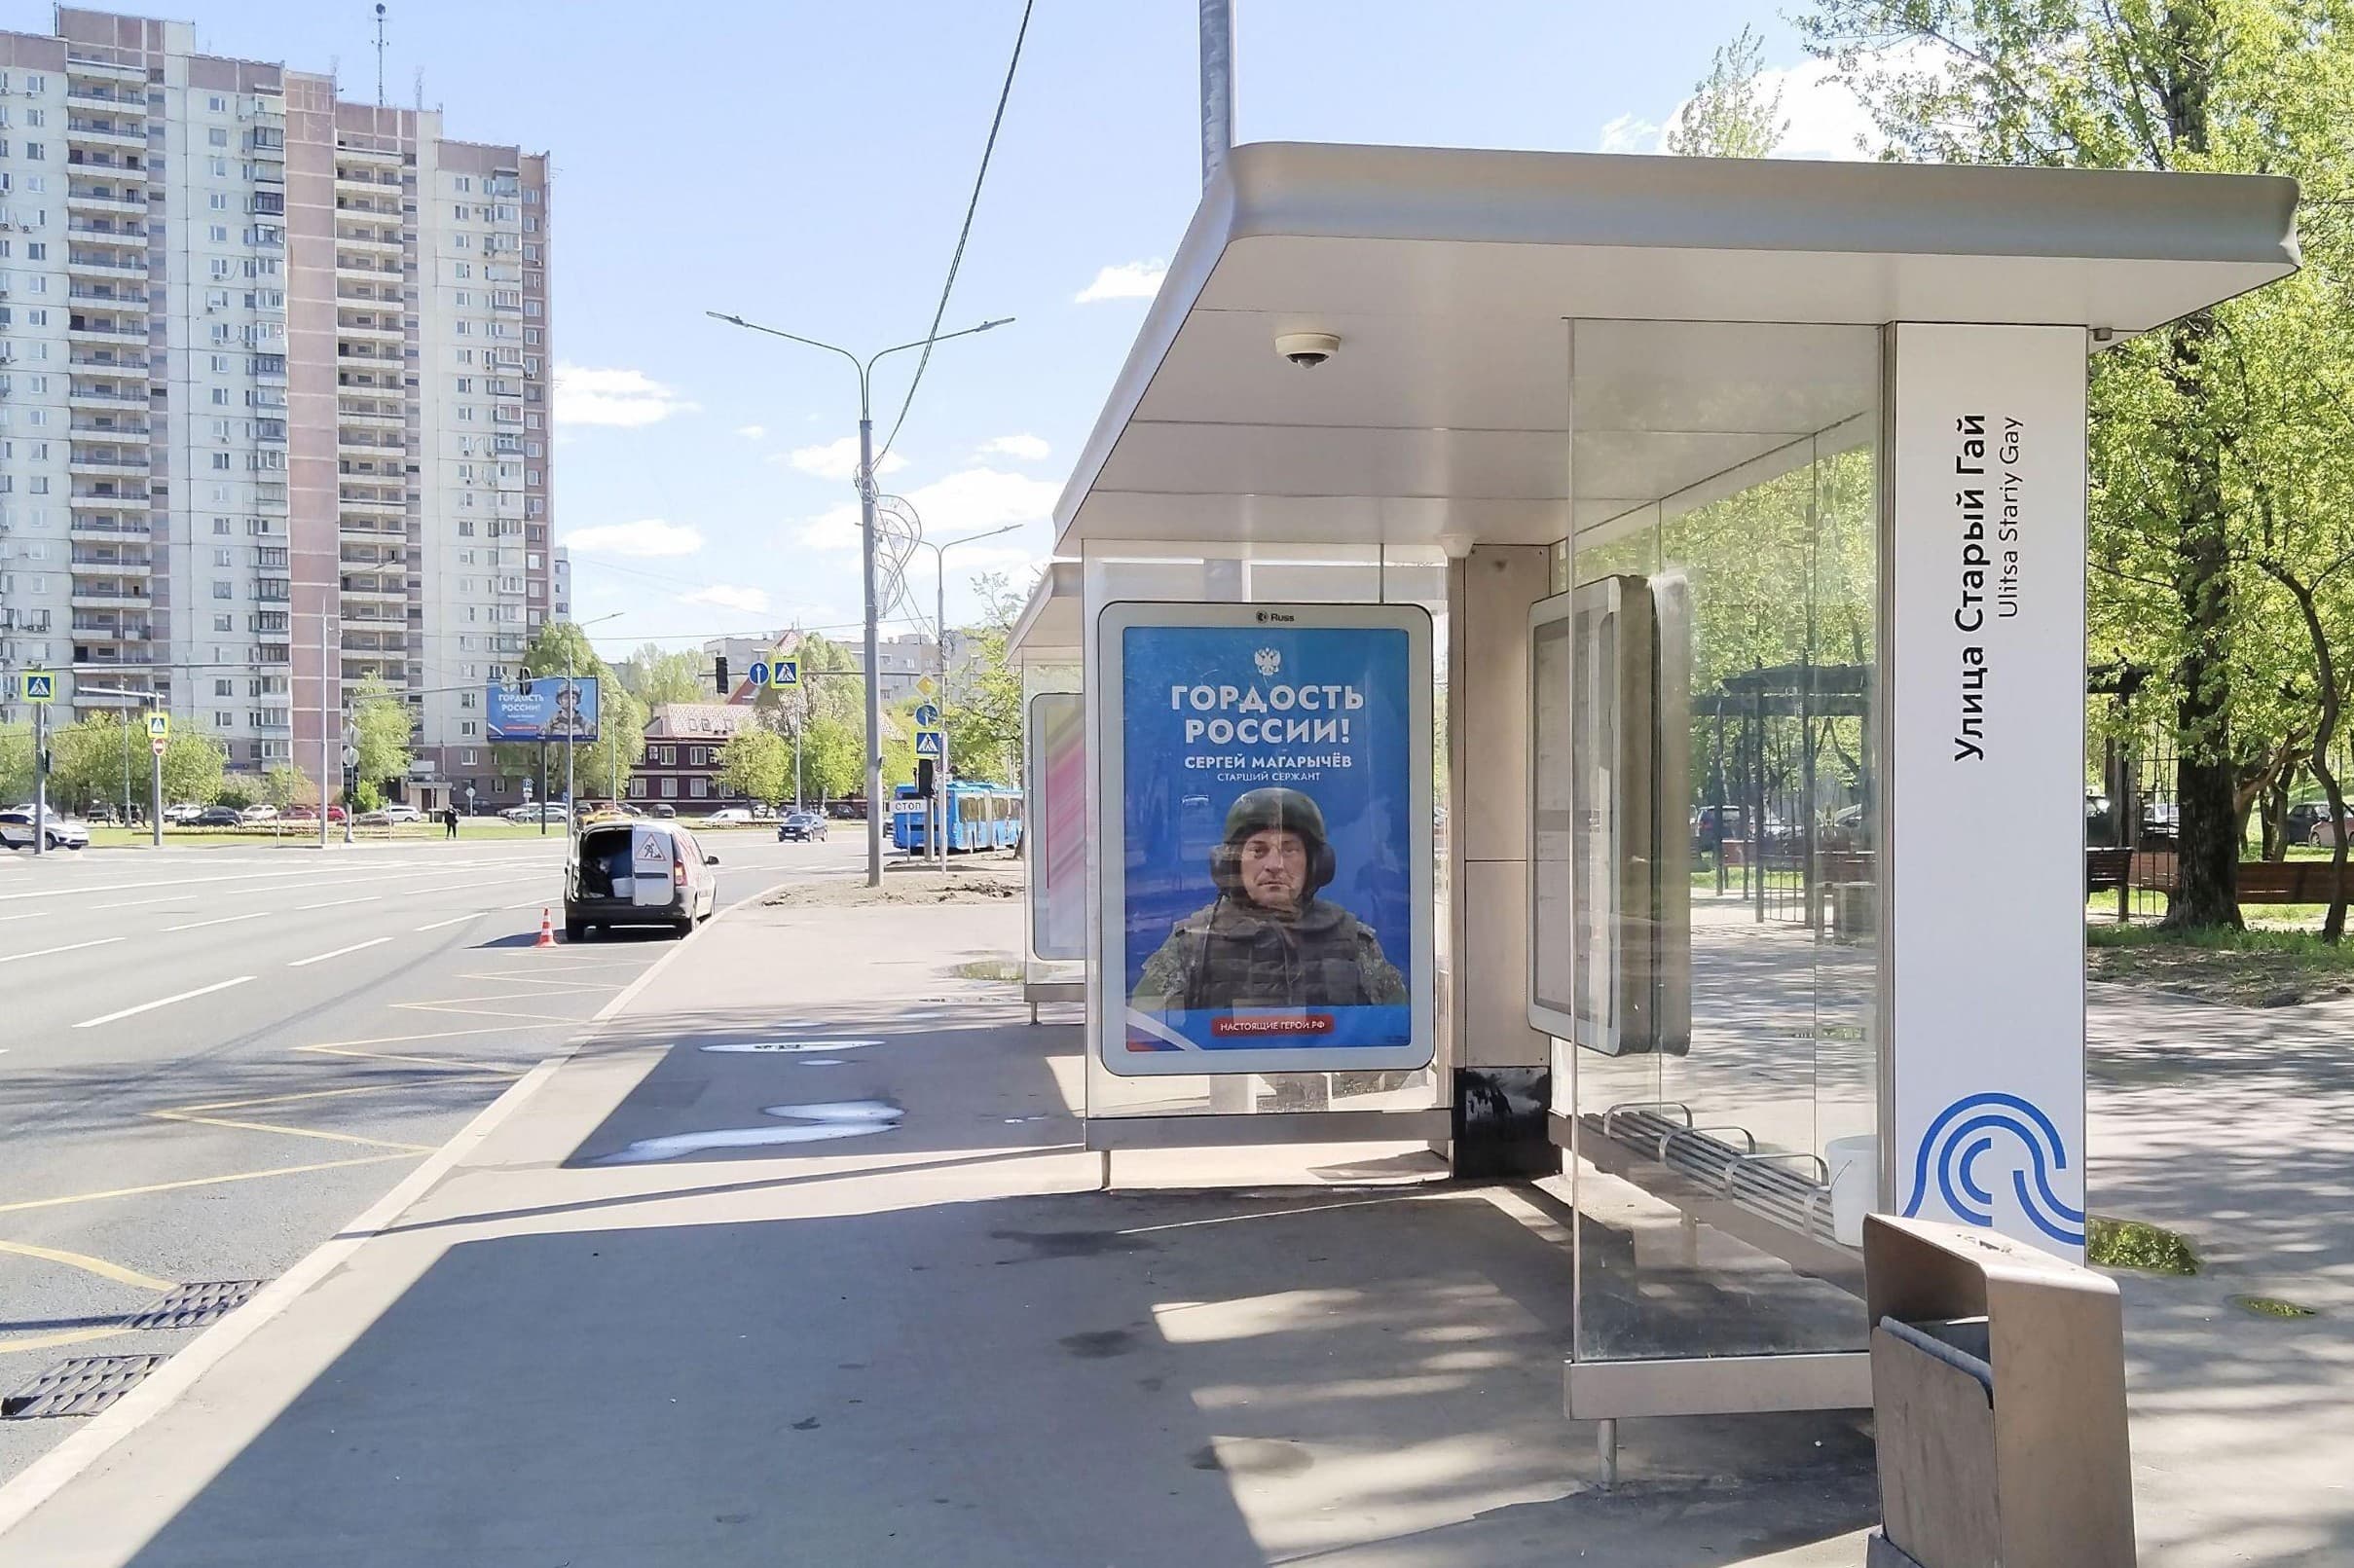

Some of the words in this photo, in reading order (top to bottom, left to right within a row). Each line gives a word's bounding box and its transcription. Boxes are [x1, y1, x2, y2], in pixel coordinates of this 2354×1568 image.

[1956, 416, 1985, 475] Гай
[1999, 417, 2024, 464] Gay
[1999, 472, 2024, 542] Stariy
[1954, 490, 1991, 633] Старый
[1997, 550, 2018, 618] Ulitsa
[1270, 612, 1295, 622] Russ
[1171, 684, 1364, 713] ГОРДОСТЬ
[1954, 646, 1988, 762] Улица
[1185, 718, 1350, 745] РОССИИ!
[1184, 753, 1245, 769] СЕРГЕЙ
[1252, 752, 1352, 769] МАГАРЫЧЁВ
[1217, 771, 1269, 783] СТАРШИЙ
[1271, 772, 1321, 782] СЕРЖАНТ
[895, 802, 922, 811] СТОП
[1220, 1021, 1278, 1032] НАСТОЯЩИЕ
